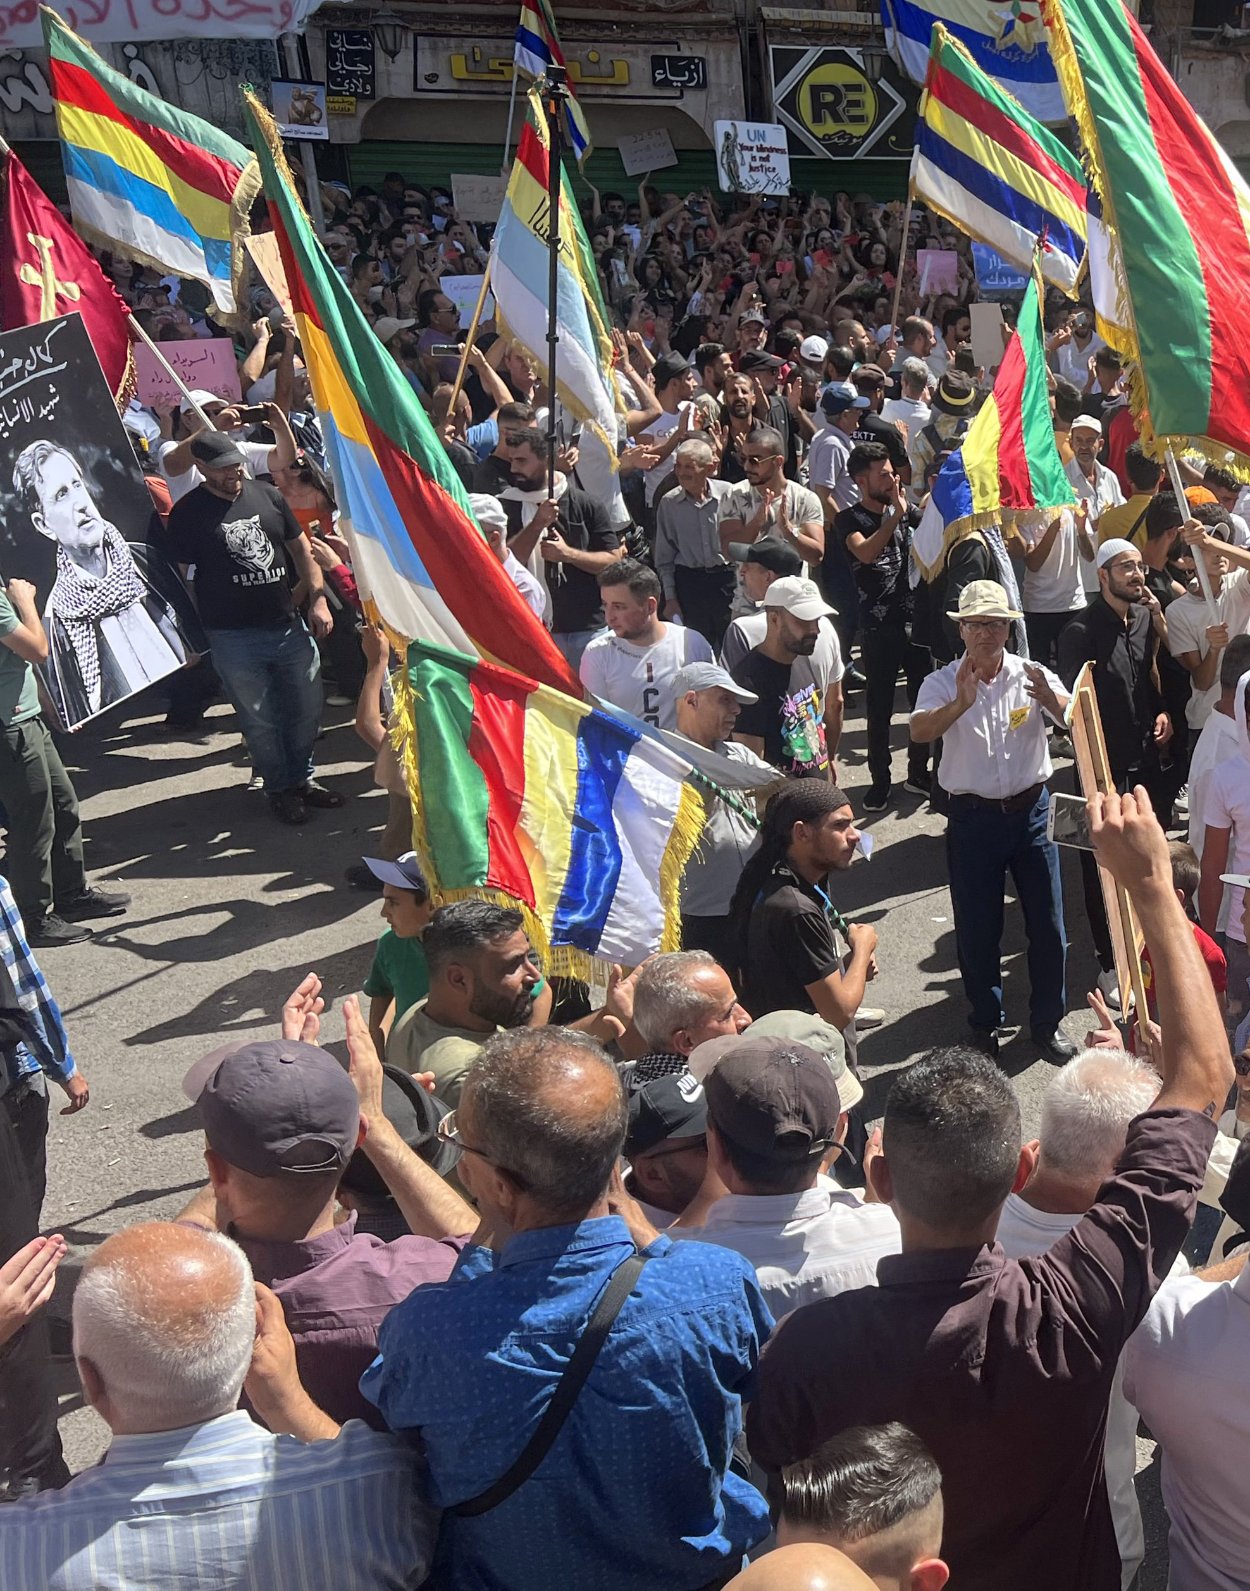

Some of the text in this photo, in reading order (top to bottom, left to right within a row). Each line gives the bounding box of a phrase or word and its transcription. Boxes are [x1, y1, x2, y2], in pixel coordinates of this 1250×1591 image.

[654, 58, 703, 87] أزياء
[808, 83, 868, 126] RE
[746, 128, 767, 143] UN
[759, 154, 771, 163] not
[172, 348, 216, 367] السويداء
